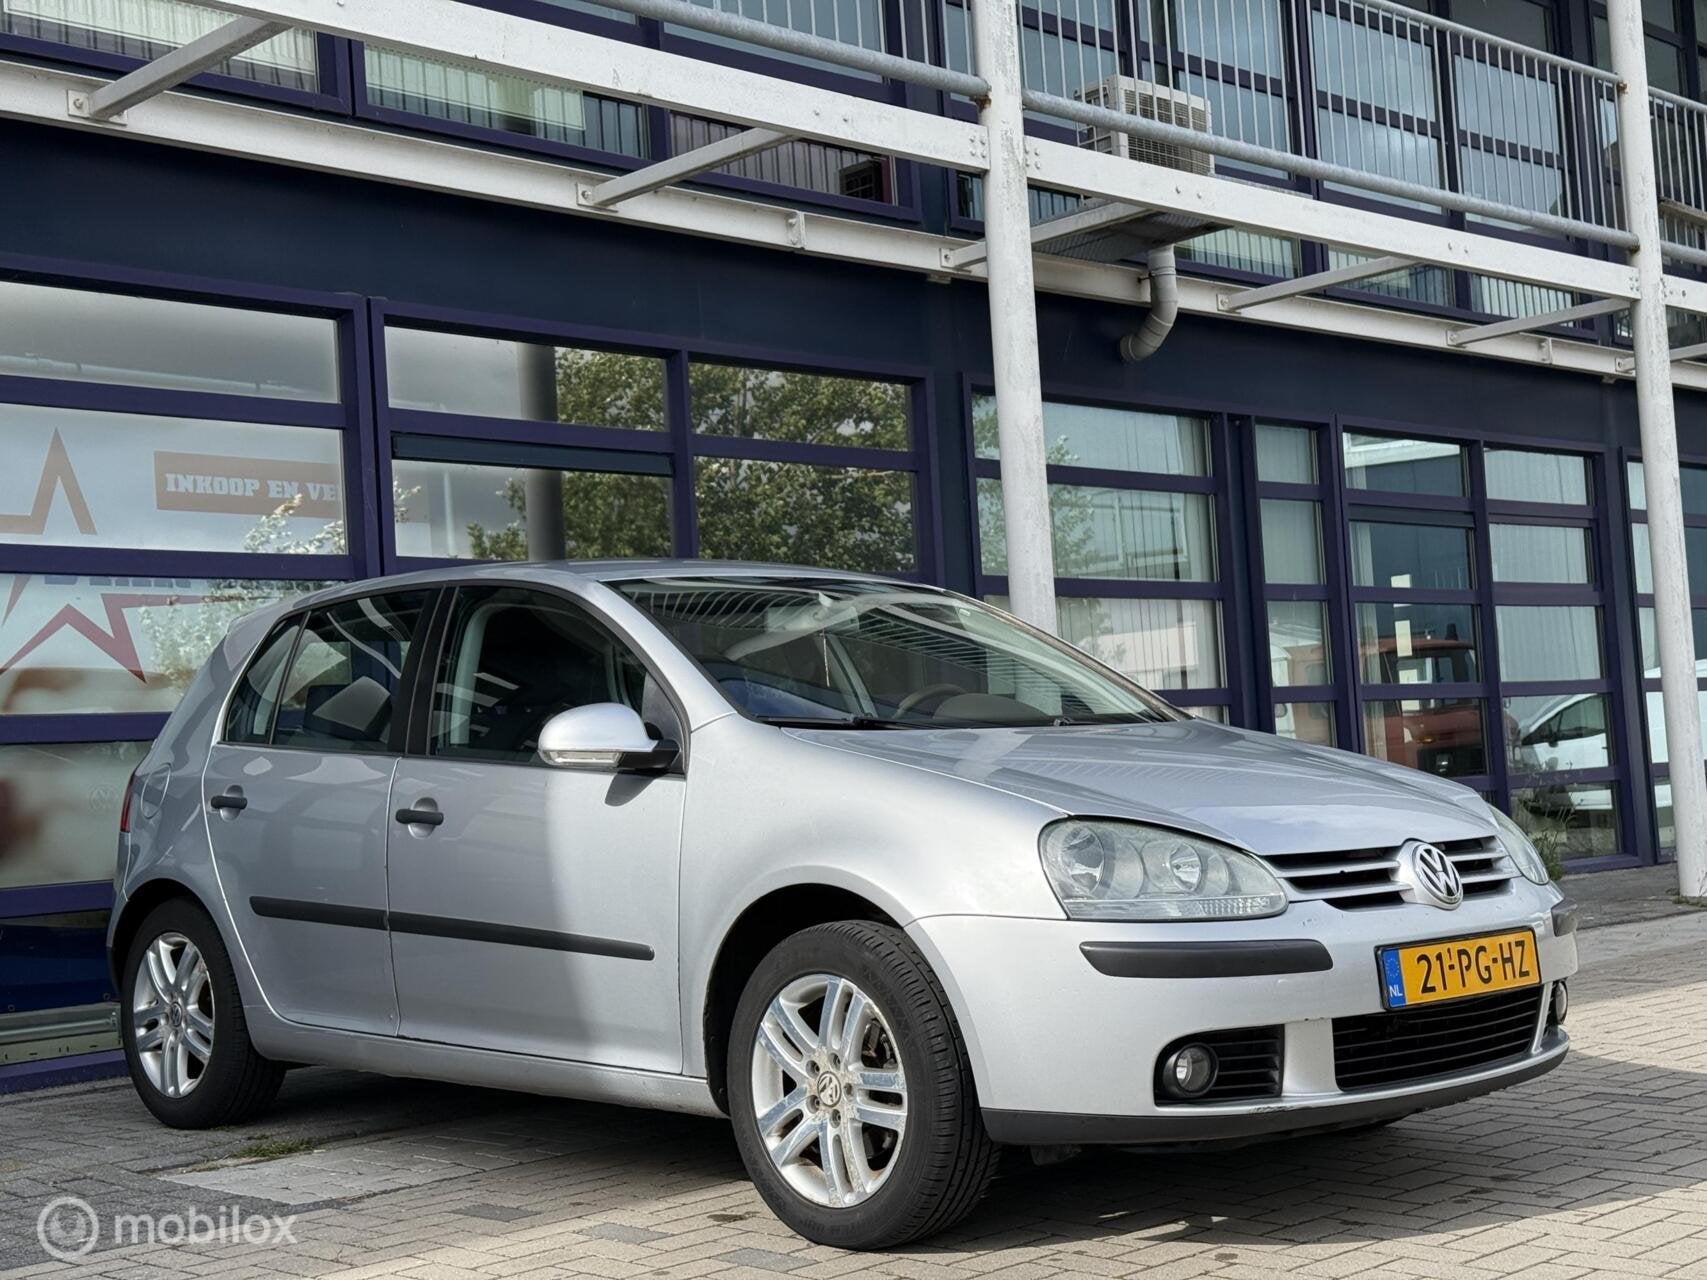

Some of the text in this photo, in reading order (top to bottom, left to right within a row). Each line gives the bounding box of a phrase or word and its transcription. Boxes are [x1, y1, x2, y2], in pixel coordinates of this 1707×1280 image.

[165, 473, 260, 497] INKOOP
[267, 480, 300, 499] EN
[1416, 940, 1530, 994] 21-PG-HZ
[1389, 984, 1403, 998] NL
